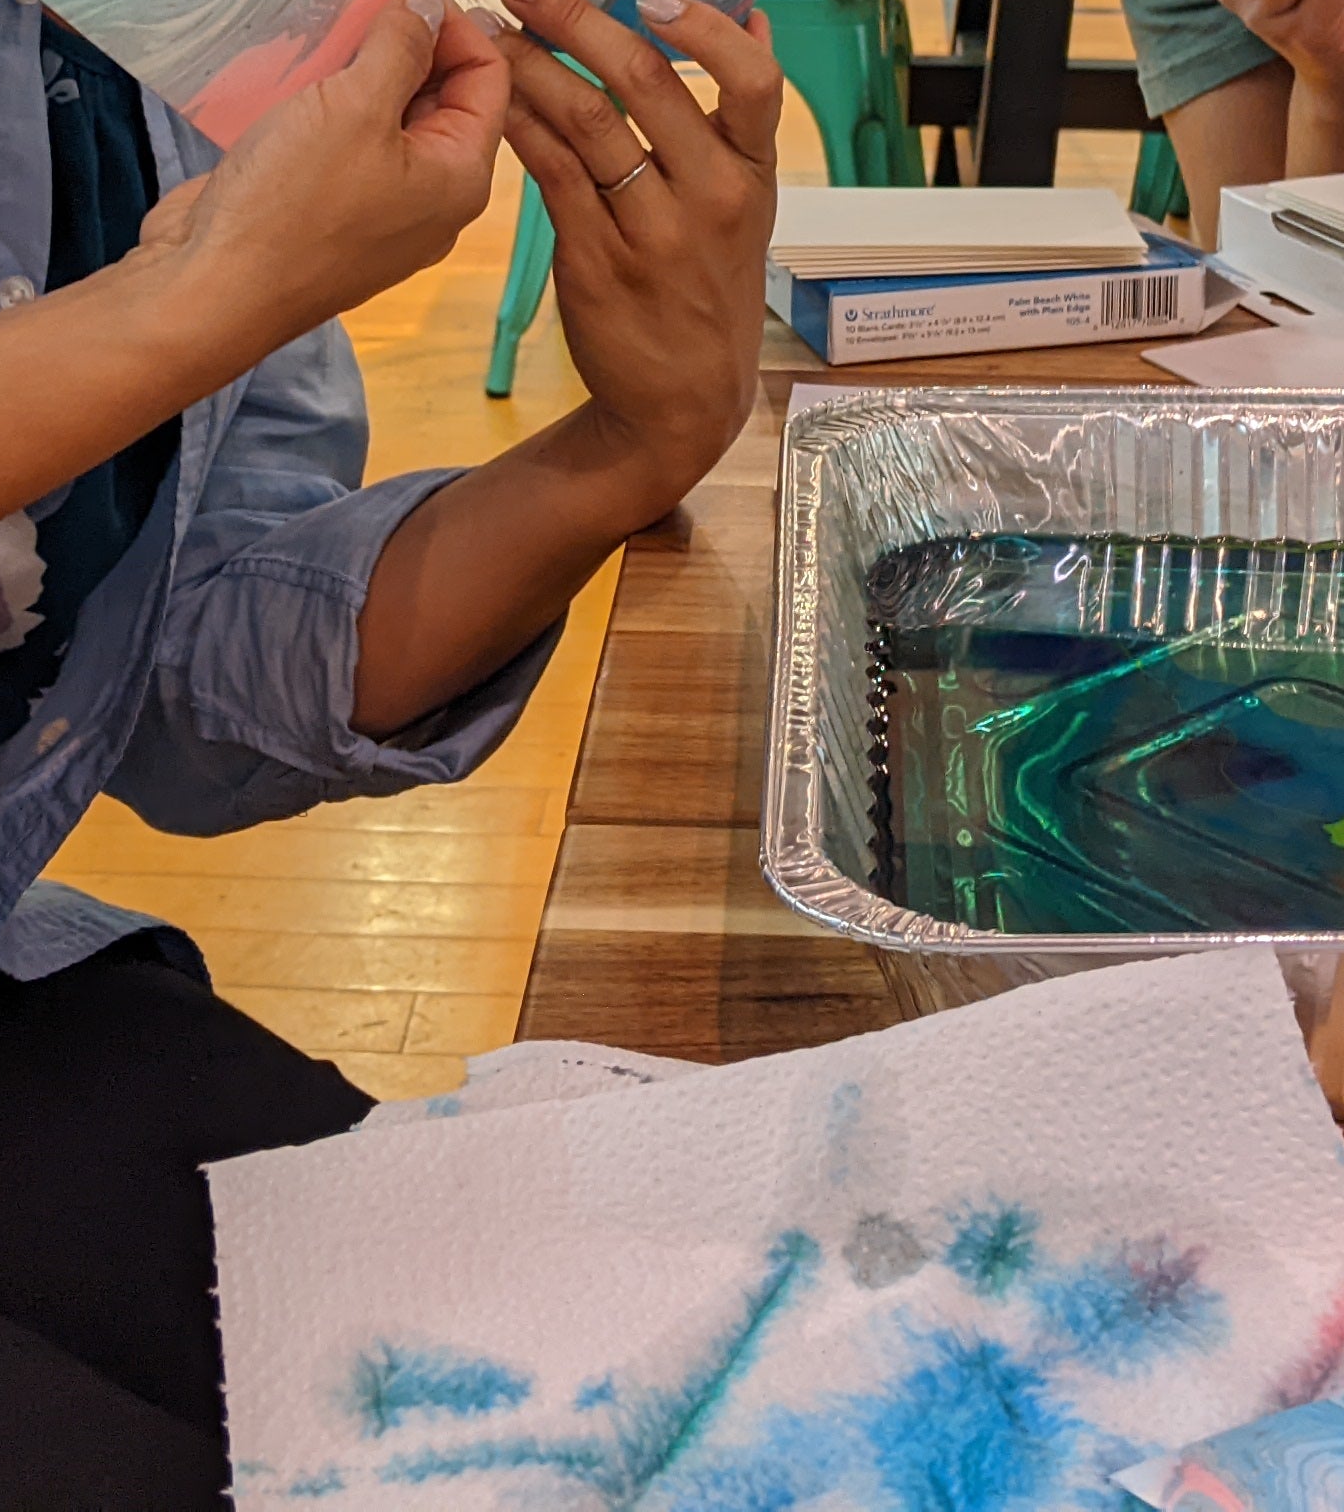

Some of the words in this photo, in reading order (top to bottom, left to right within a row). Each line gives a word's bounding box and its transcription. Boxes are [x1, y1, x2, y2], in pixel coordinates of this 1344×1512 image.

[1009, 297, 1030, 306] Palm
[1033, 294, 1061, 304] Beach
[1064, 292, 1091, 302] White
[862, 304, 934, 320] Strathmore
[1019, 308, 1040, 317] with
[1042, 306, 1064, 314] Plain
[1067, 304, 1090, 313] Edge
